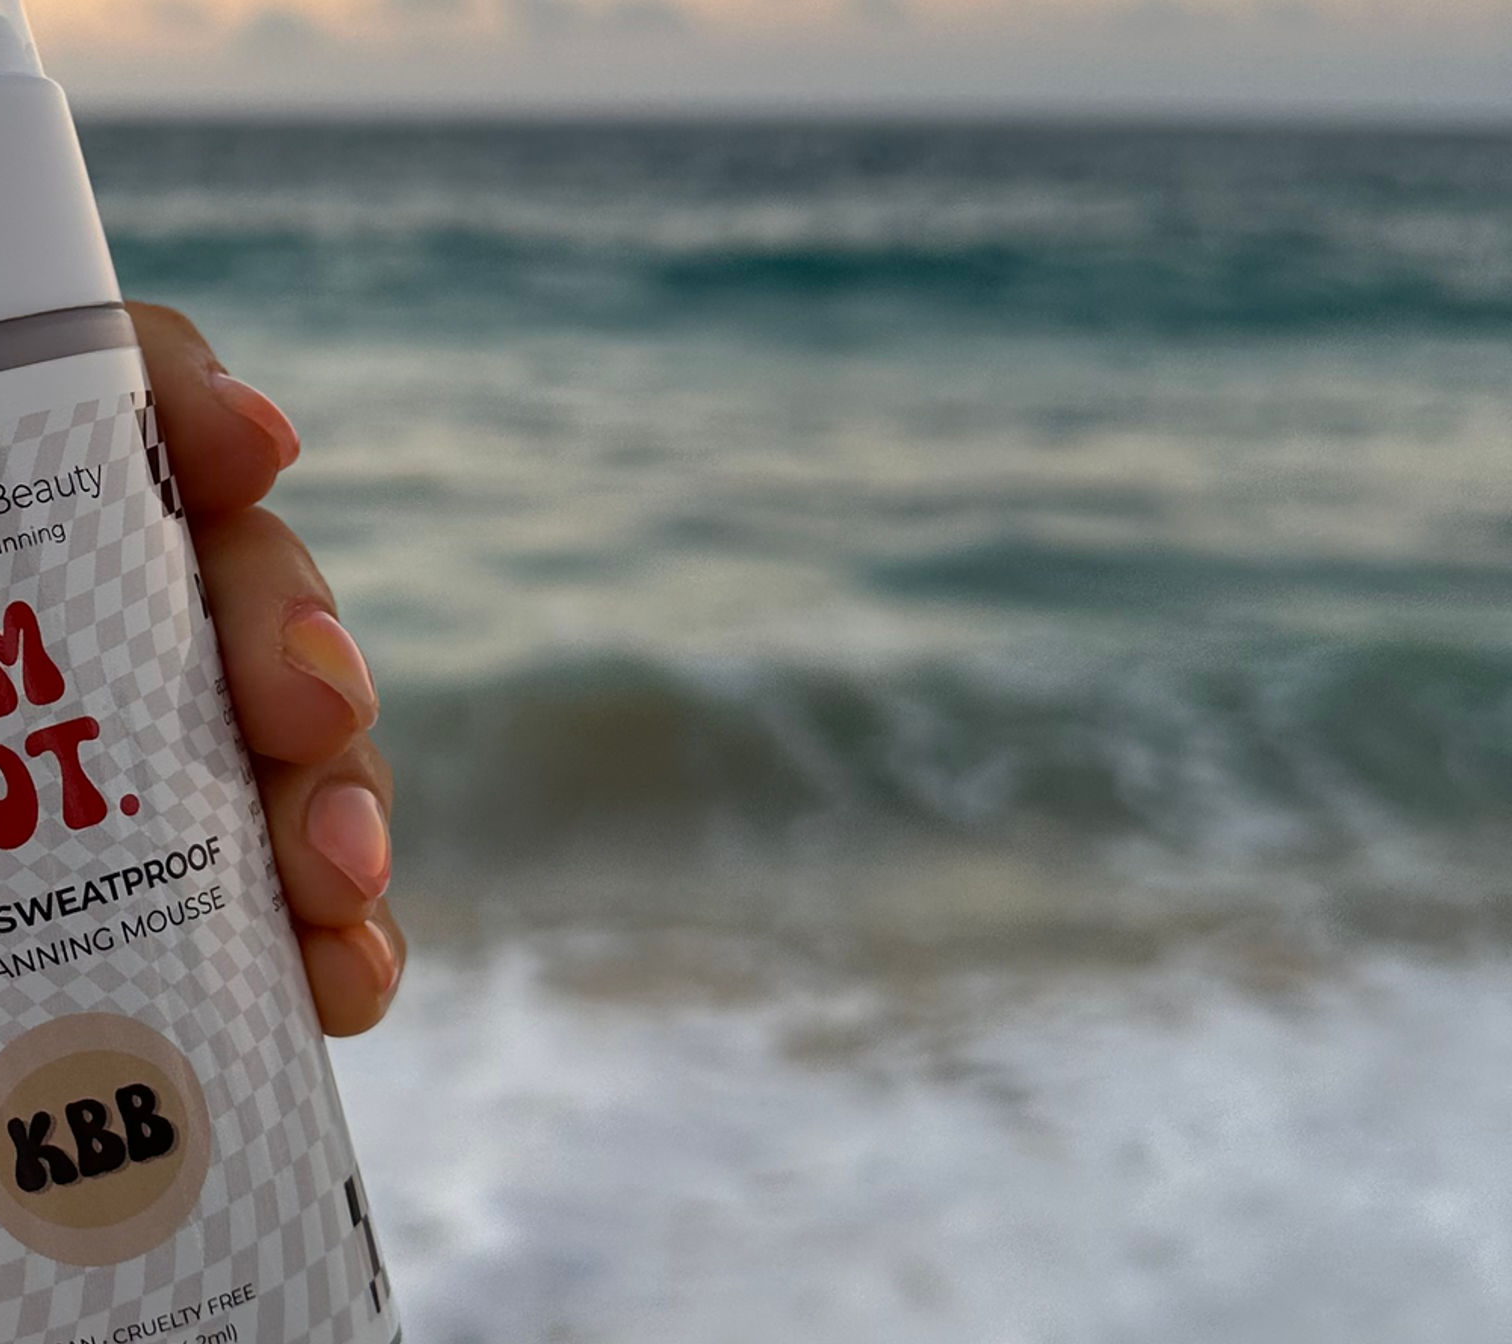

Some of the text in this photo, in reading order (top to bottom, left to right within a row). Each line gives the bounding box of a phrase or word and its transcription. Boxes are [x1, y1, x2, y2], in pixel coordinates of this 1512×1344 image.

[120, 886, 226, 944] MOUSSE
[7, 1083, 178, 1193] KBB
[112, 1304, 202, 1344] CRUELTY
[207, 1283, 257, 1316] FREE
